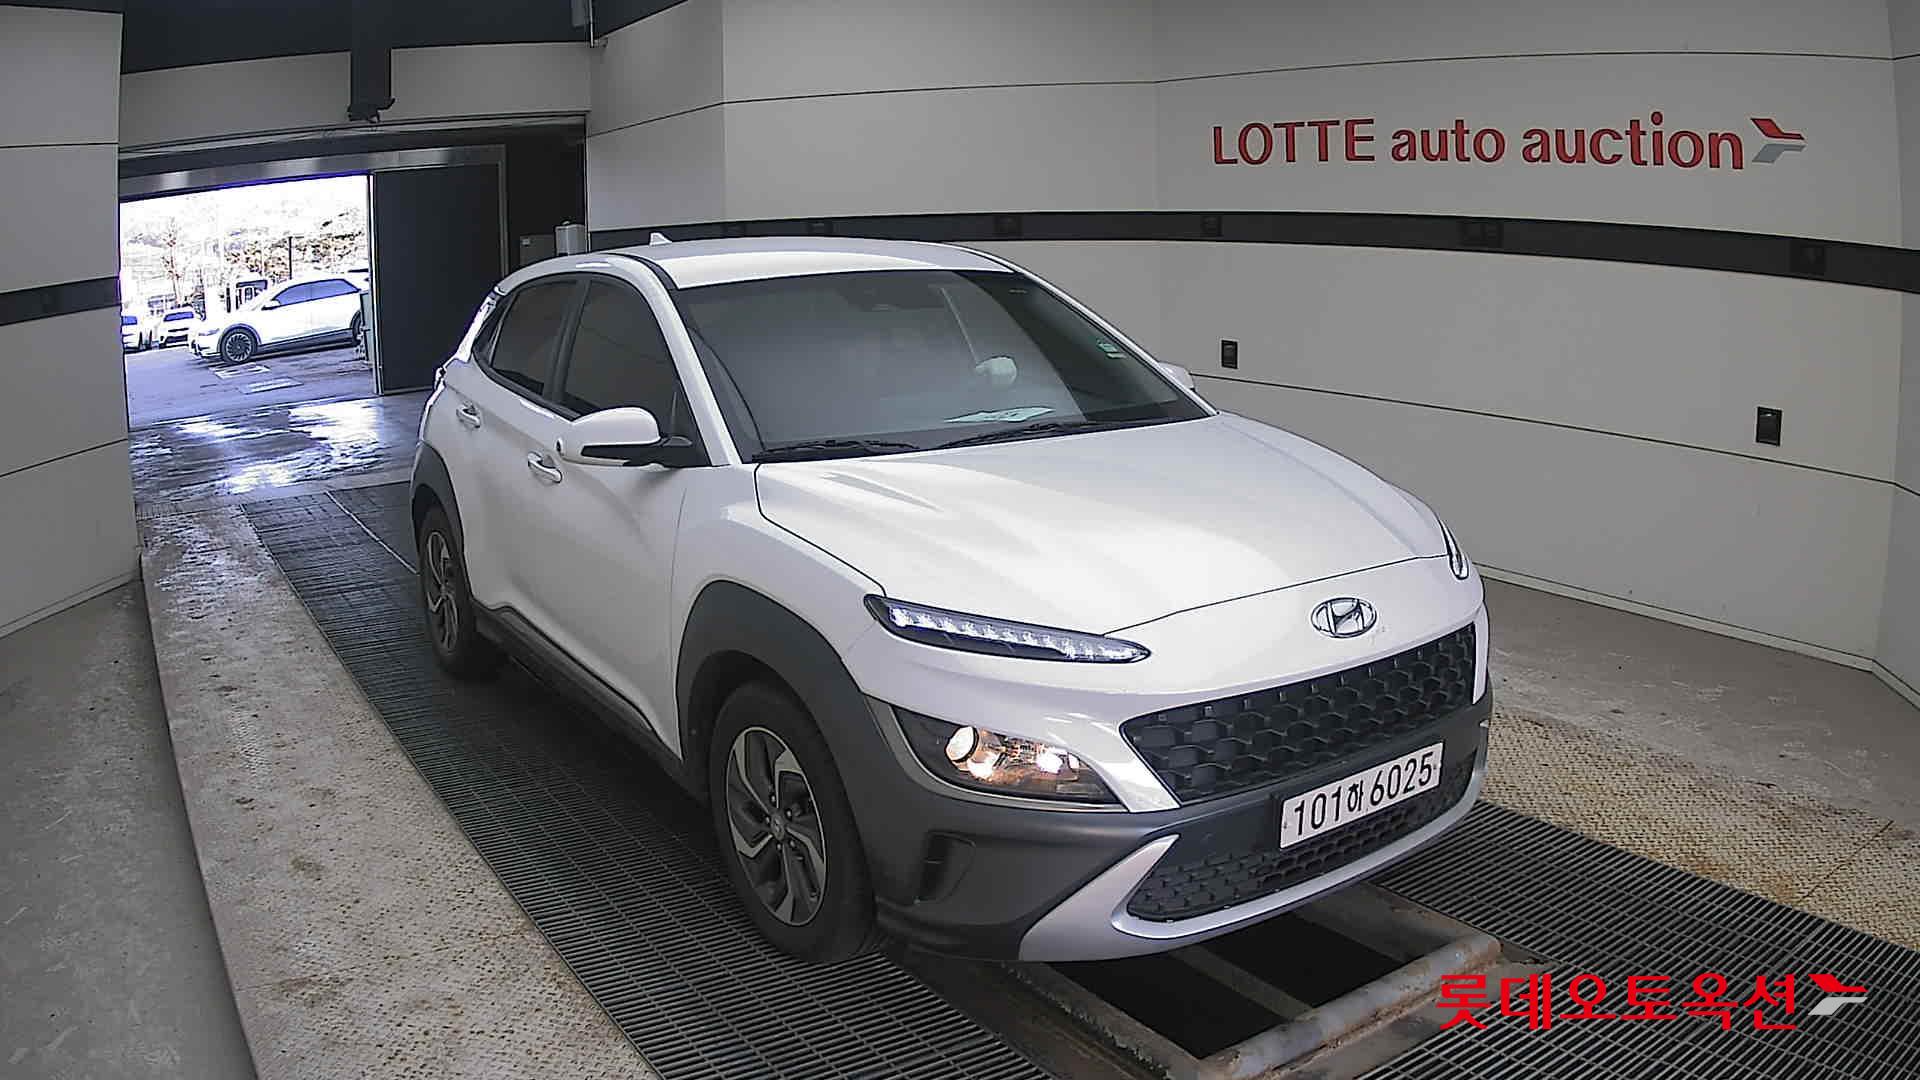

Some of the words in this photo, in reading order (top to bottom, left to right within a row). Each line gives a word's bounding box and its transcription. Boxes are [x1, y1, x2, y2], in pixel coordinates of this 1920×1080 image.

[1212, 118, 1376, 165] LOTTE
[1391, 120, 1507, 163] auto
[1522, 112, 1744, 170] auction
